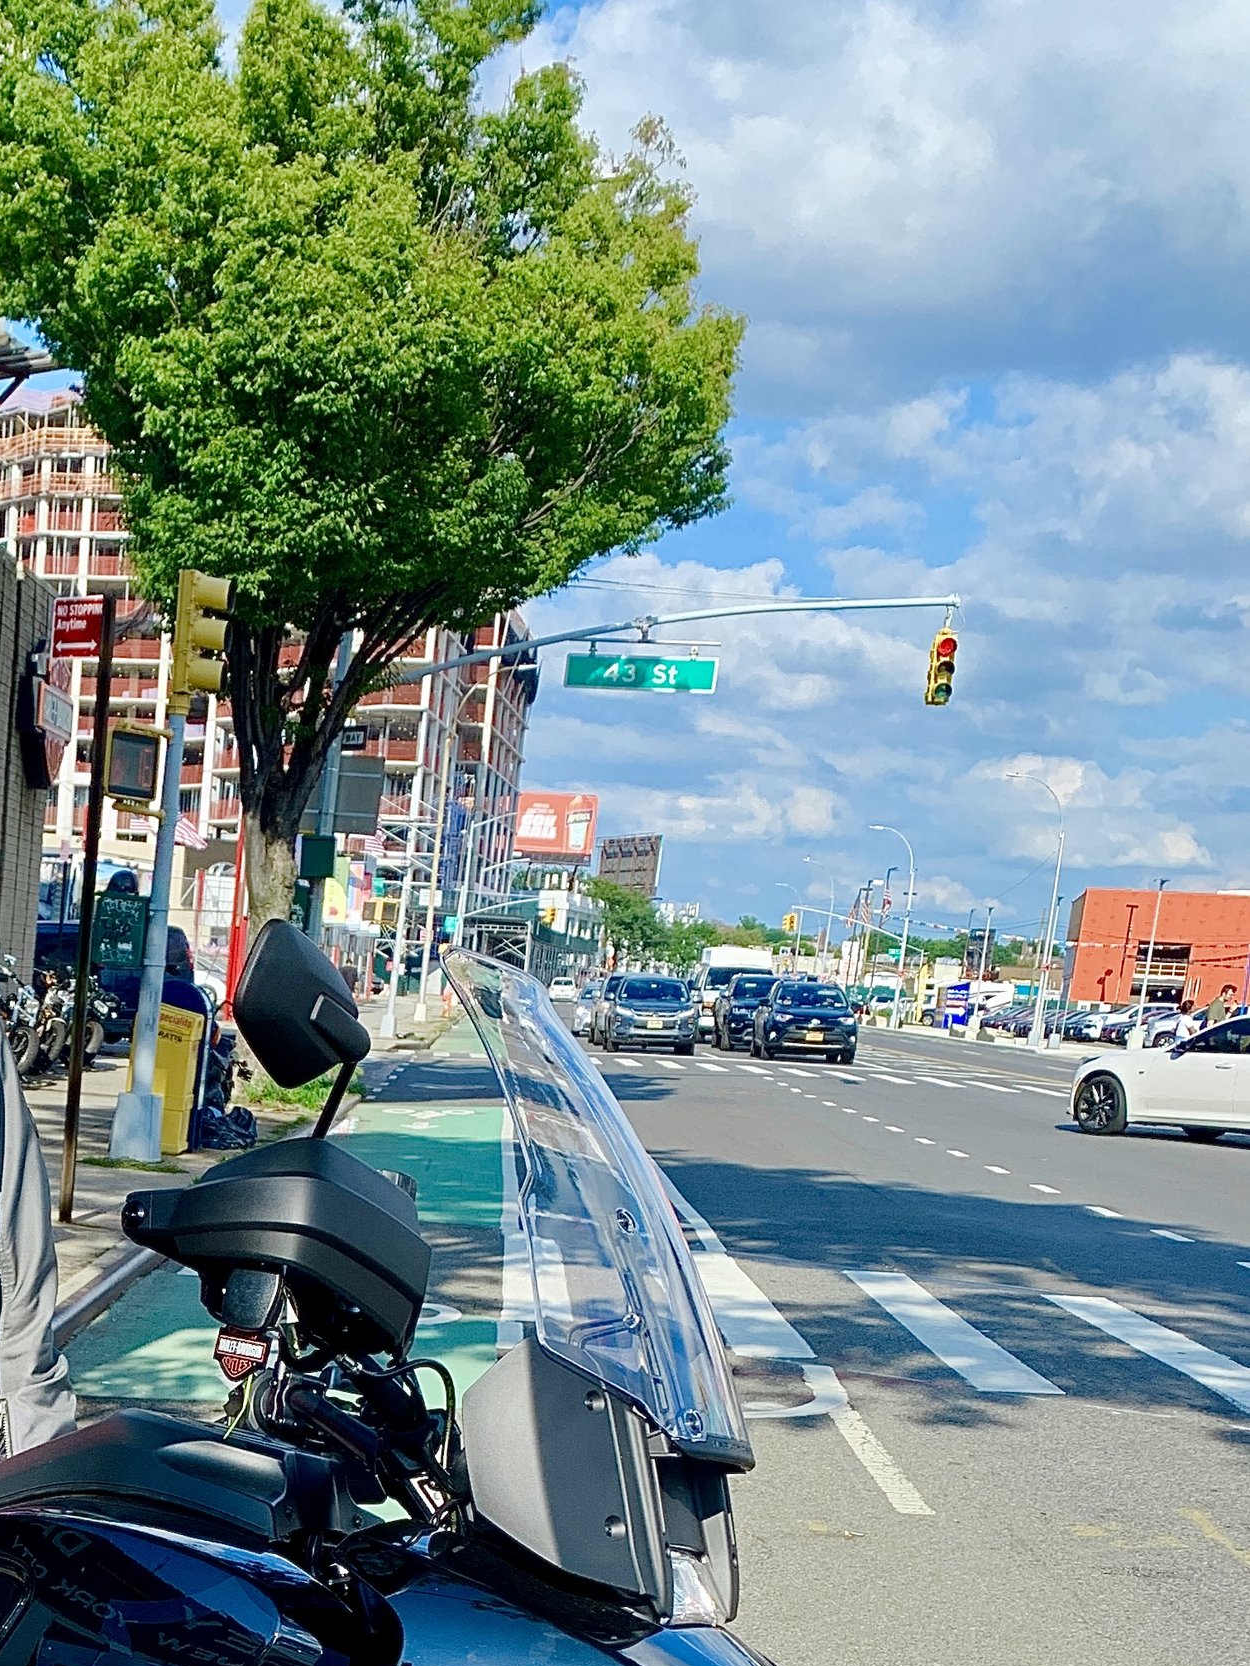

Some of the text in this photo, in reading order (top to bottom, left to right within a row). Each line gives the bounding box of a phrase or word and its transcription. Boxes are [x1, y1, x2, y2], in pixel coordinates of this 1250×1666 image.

[56, 603, 103, 617] NO STOPPIN
[56, 618, 87, 632] Anytime
[603, 663, 678, 685] 43 St
[158, 1030, 183, 1043] RATIS
